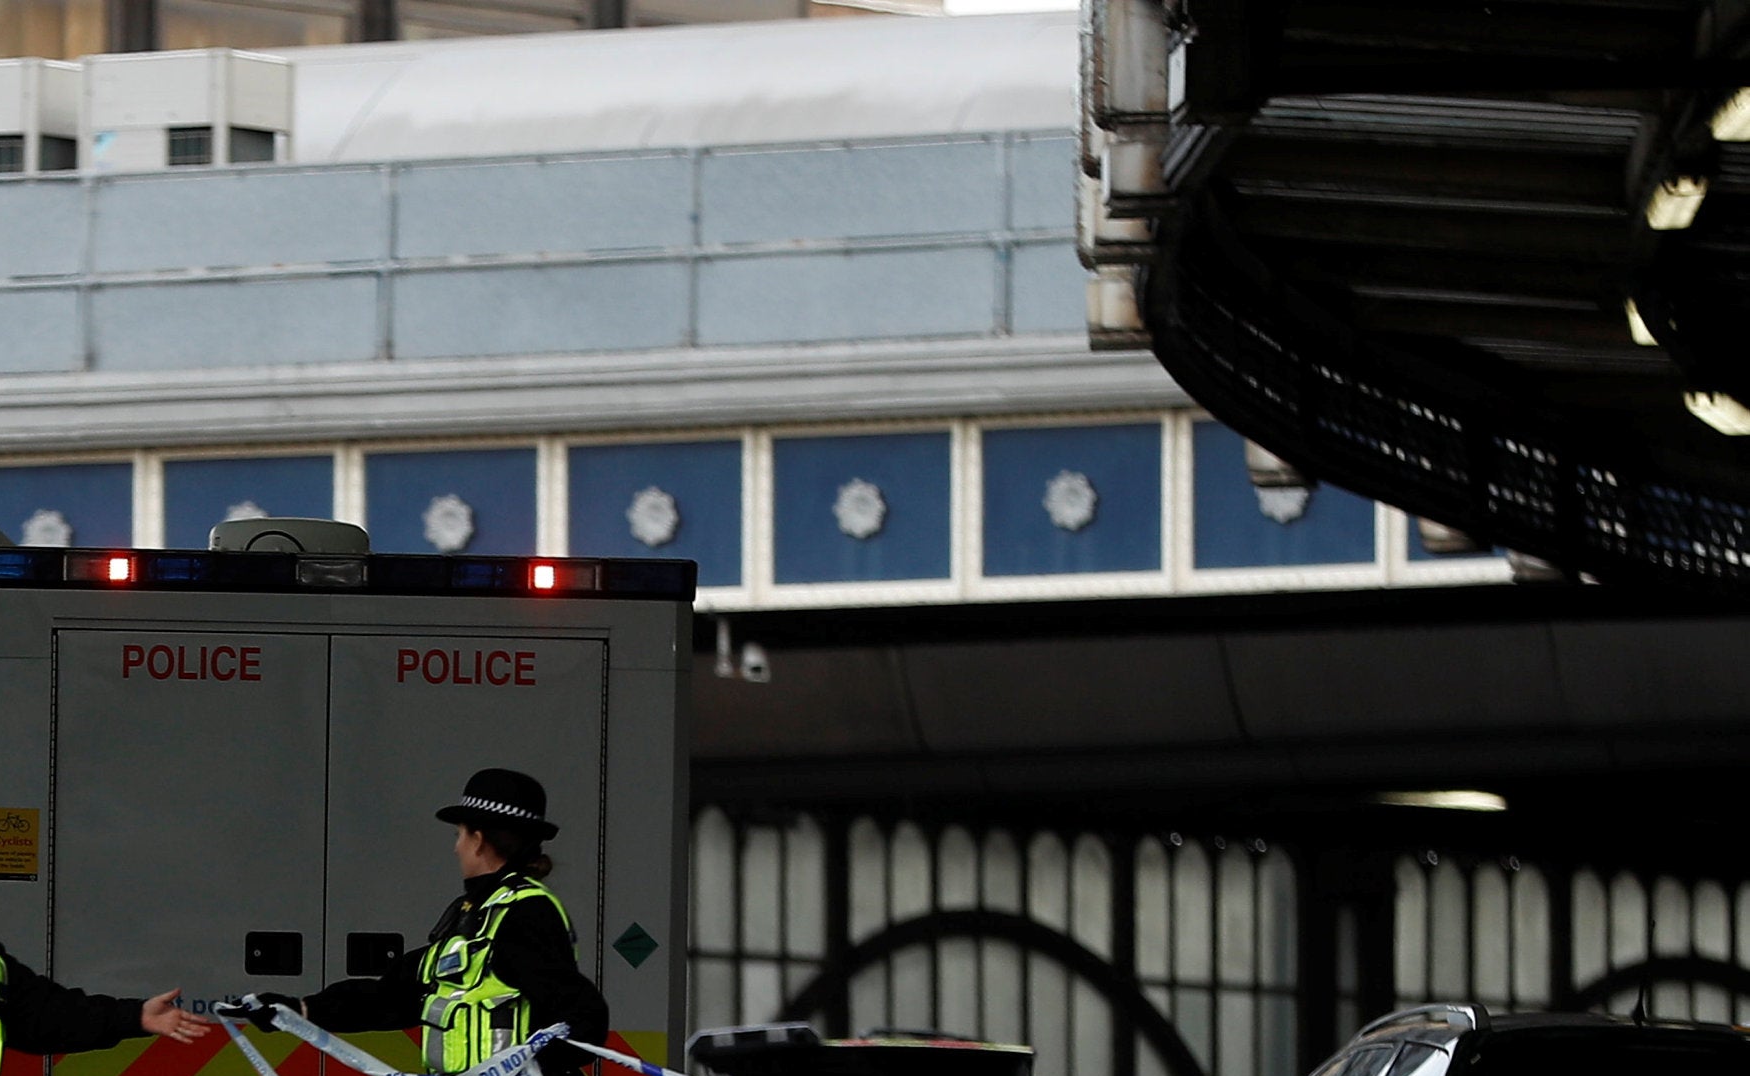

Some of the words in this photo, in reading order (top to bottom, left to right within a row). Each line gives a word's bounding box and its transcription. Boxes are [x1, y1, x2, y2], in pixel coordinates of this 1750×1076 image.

[122, 644, 262, 682] POLICE
[396, 648, 537, 686] POLICE
[499, 1050, 528, 1075] NOT
